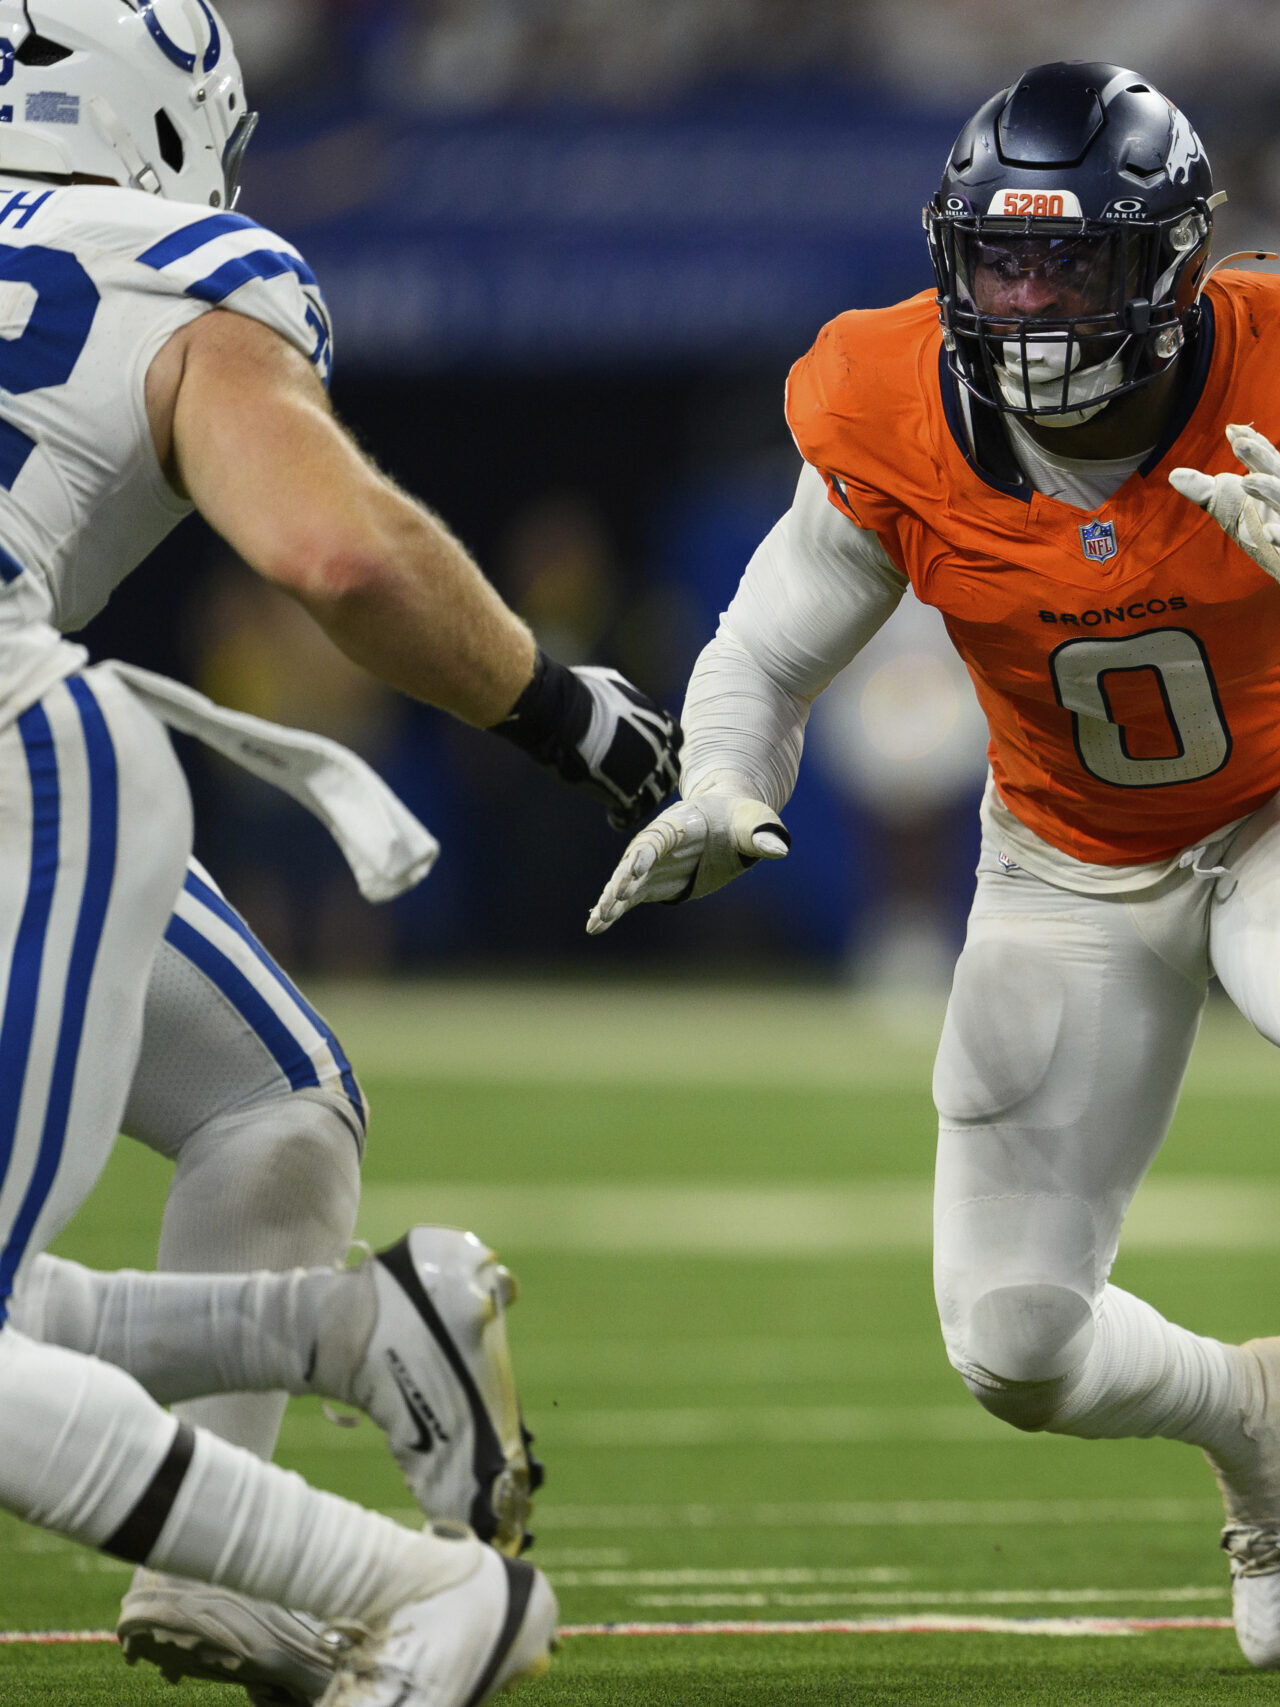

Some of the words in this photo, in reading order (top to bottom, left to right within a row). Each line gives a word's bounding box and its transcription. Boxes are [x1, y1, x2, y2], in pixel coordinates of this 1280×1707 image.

[0, 189, 56, 229] H
[1003, 193, 1064, 218] 5280
[1087, 537, 1112, 556] NFL
[1038, 596, 1188, 627] BRONCOS
[1049, 626, 1233, 789] 0
